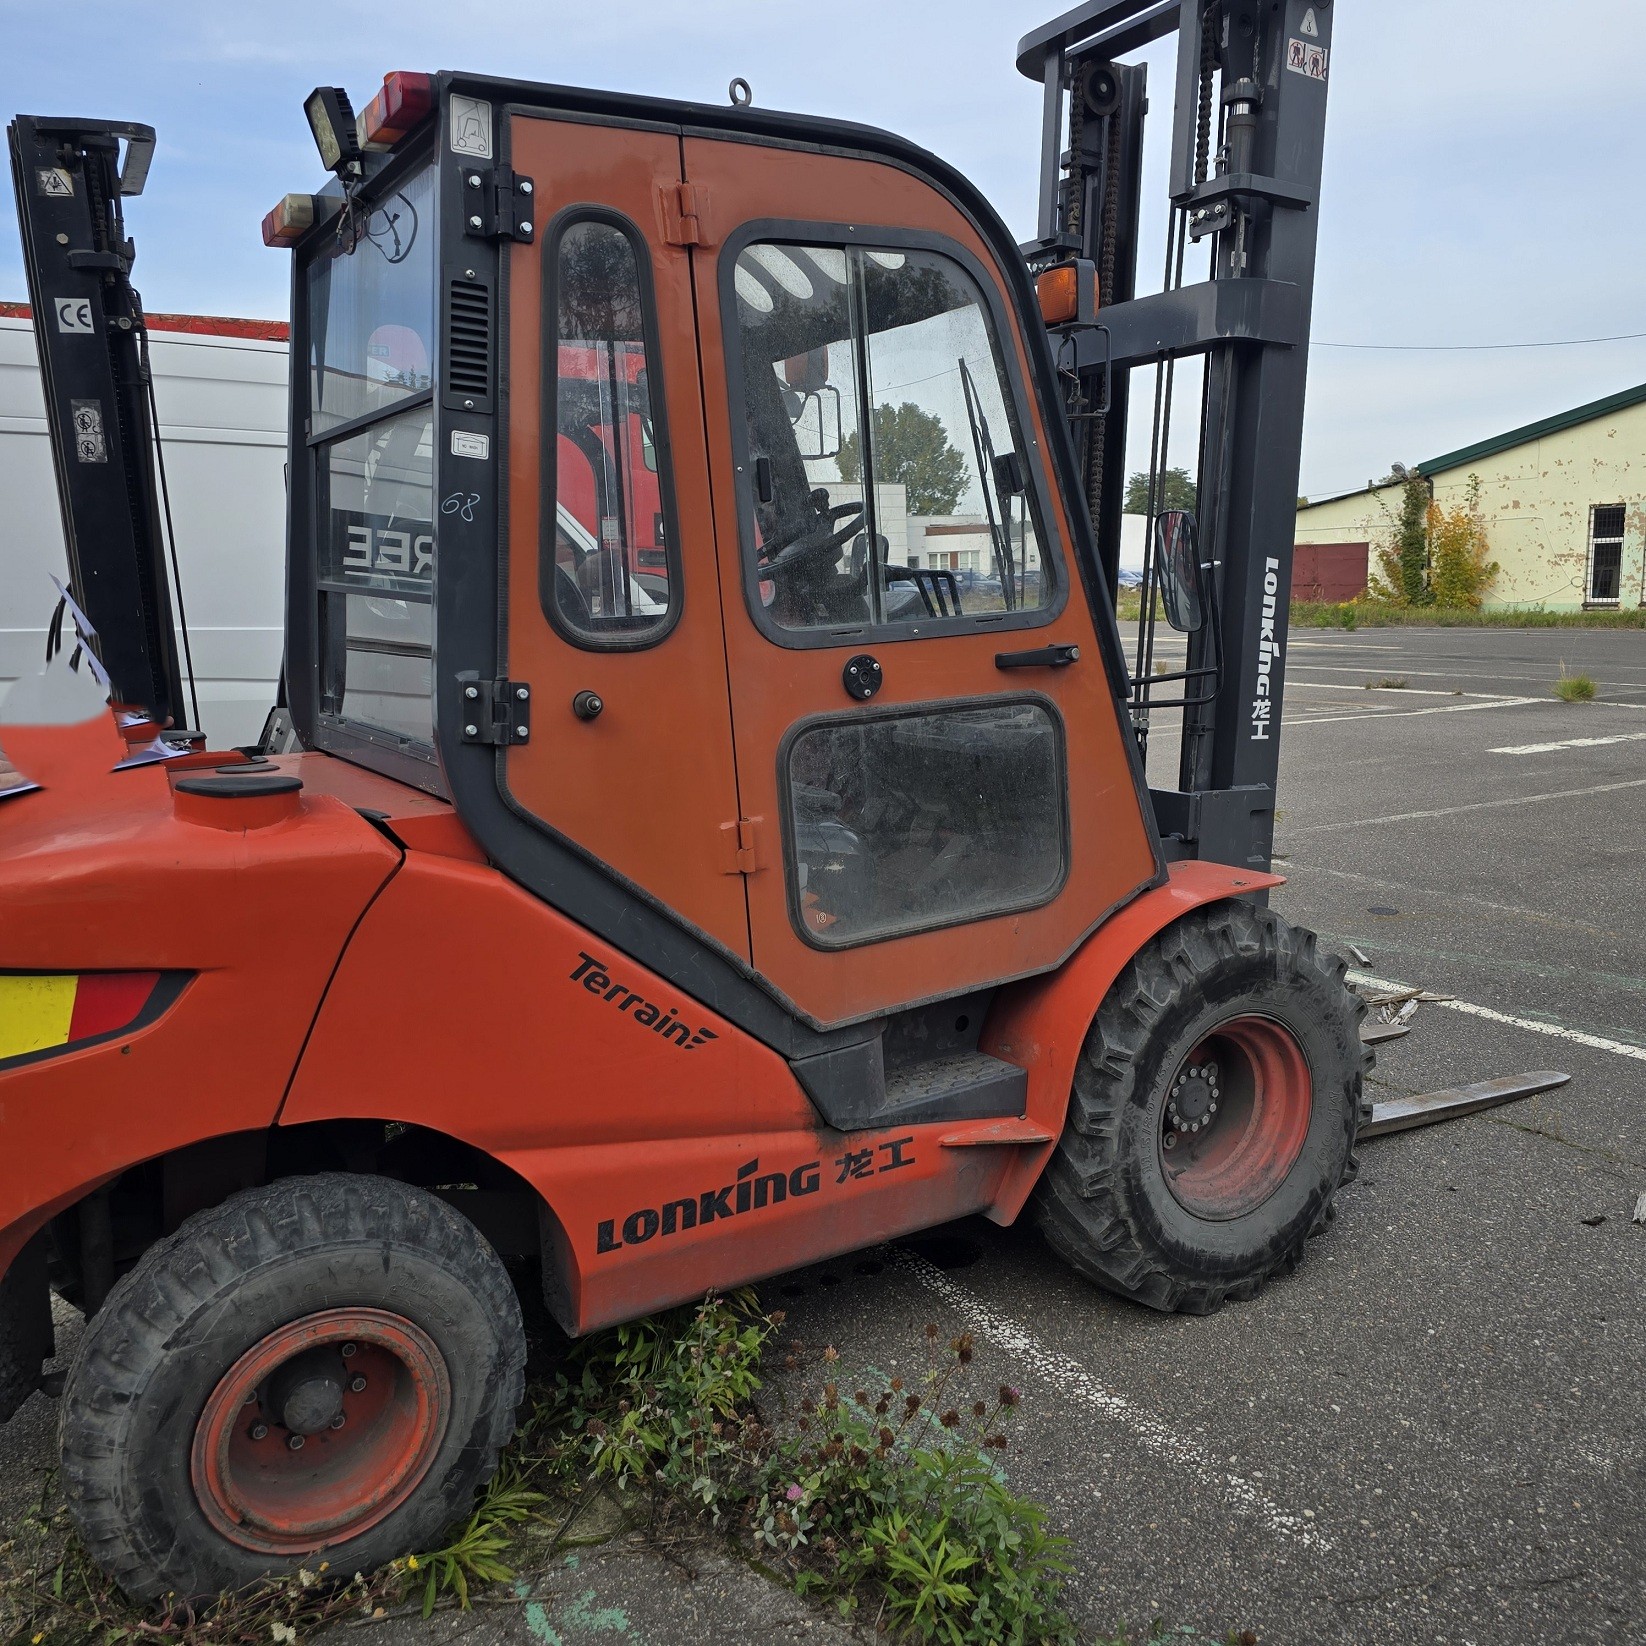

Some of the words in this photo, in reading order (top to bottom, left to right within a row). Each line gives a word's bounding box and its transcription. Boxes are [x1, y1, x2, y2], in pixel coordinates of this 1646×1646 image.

[59, 303, 92, 328] CE
[441, 492, 480, 522] 68
[569, 951, 698, 1049] Terrain
